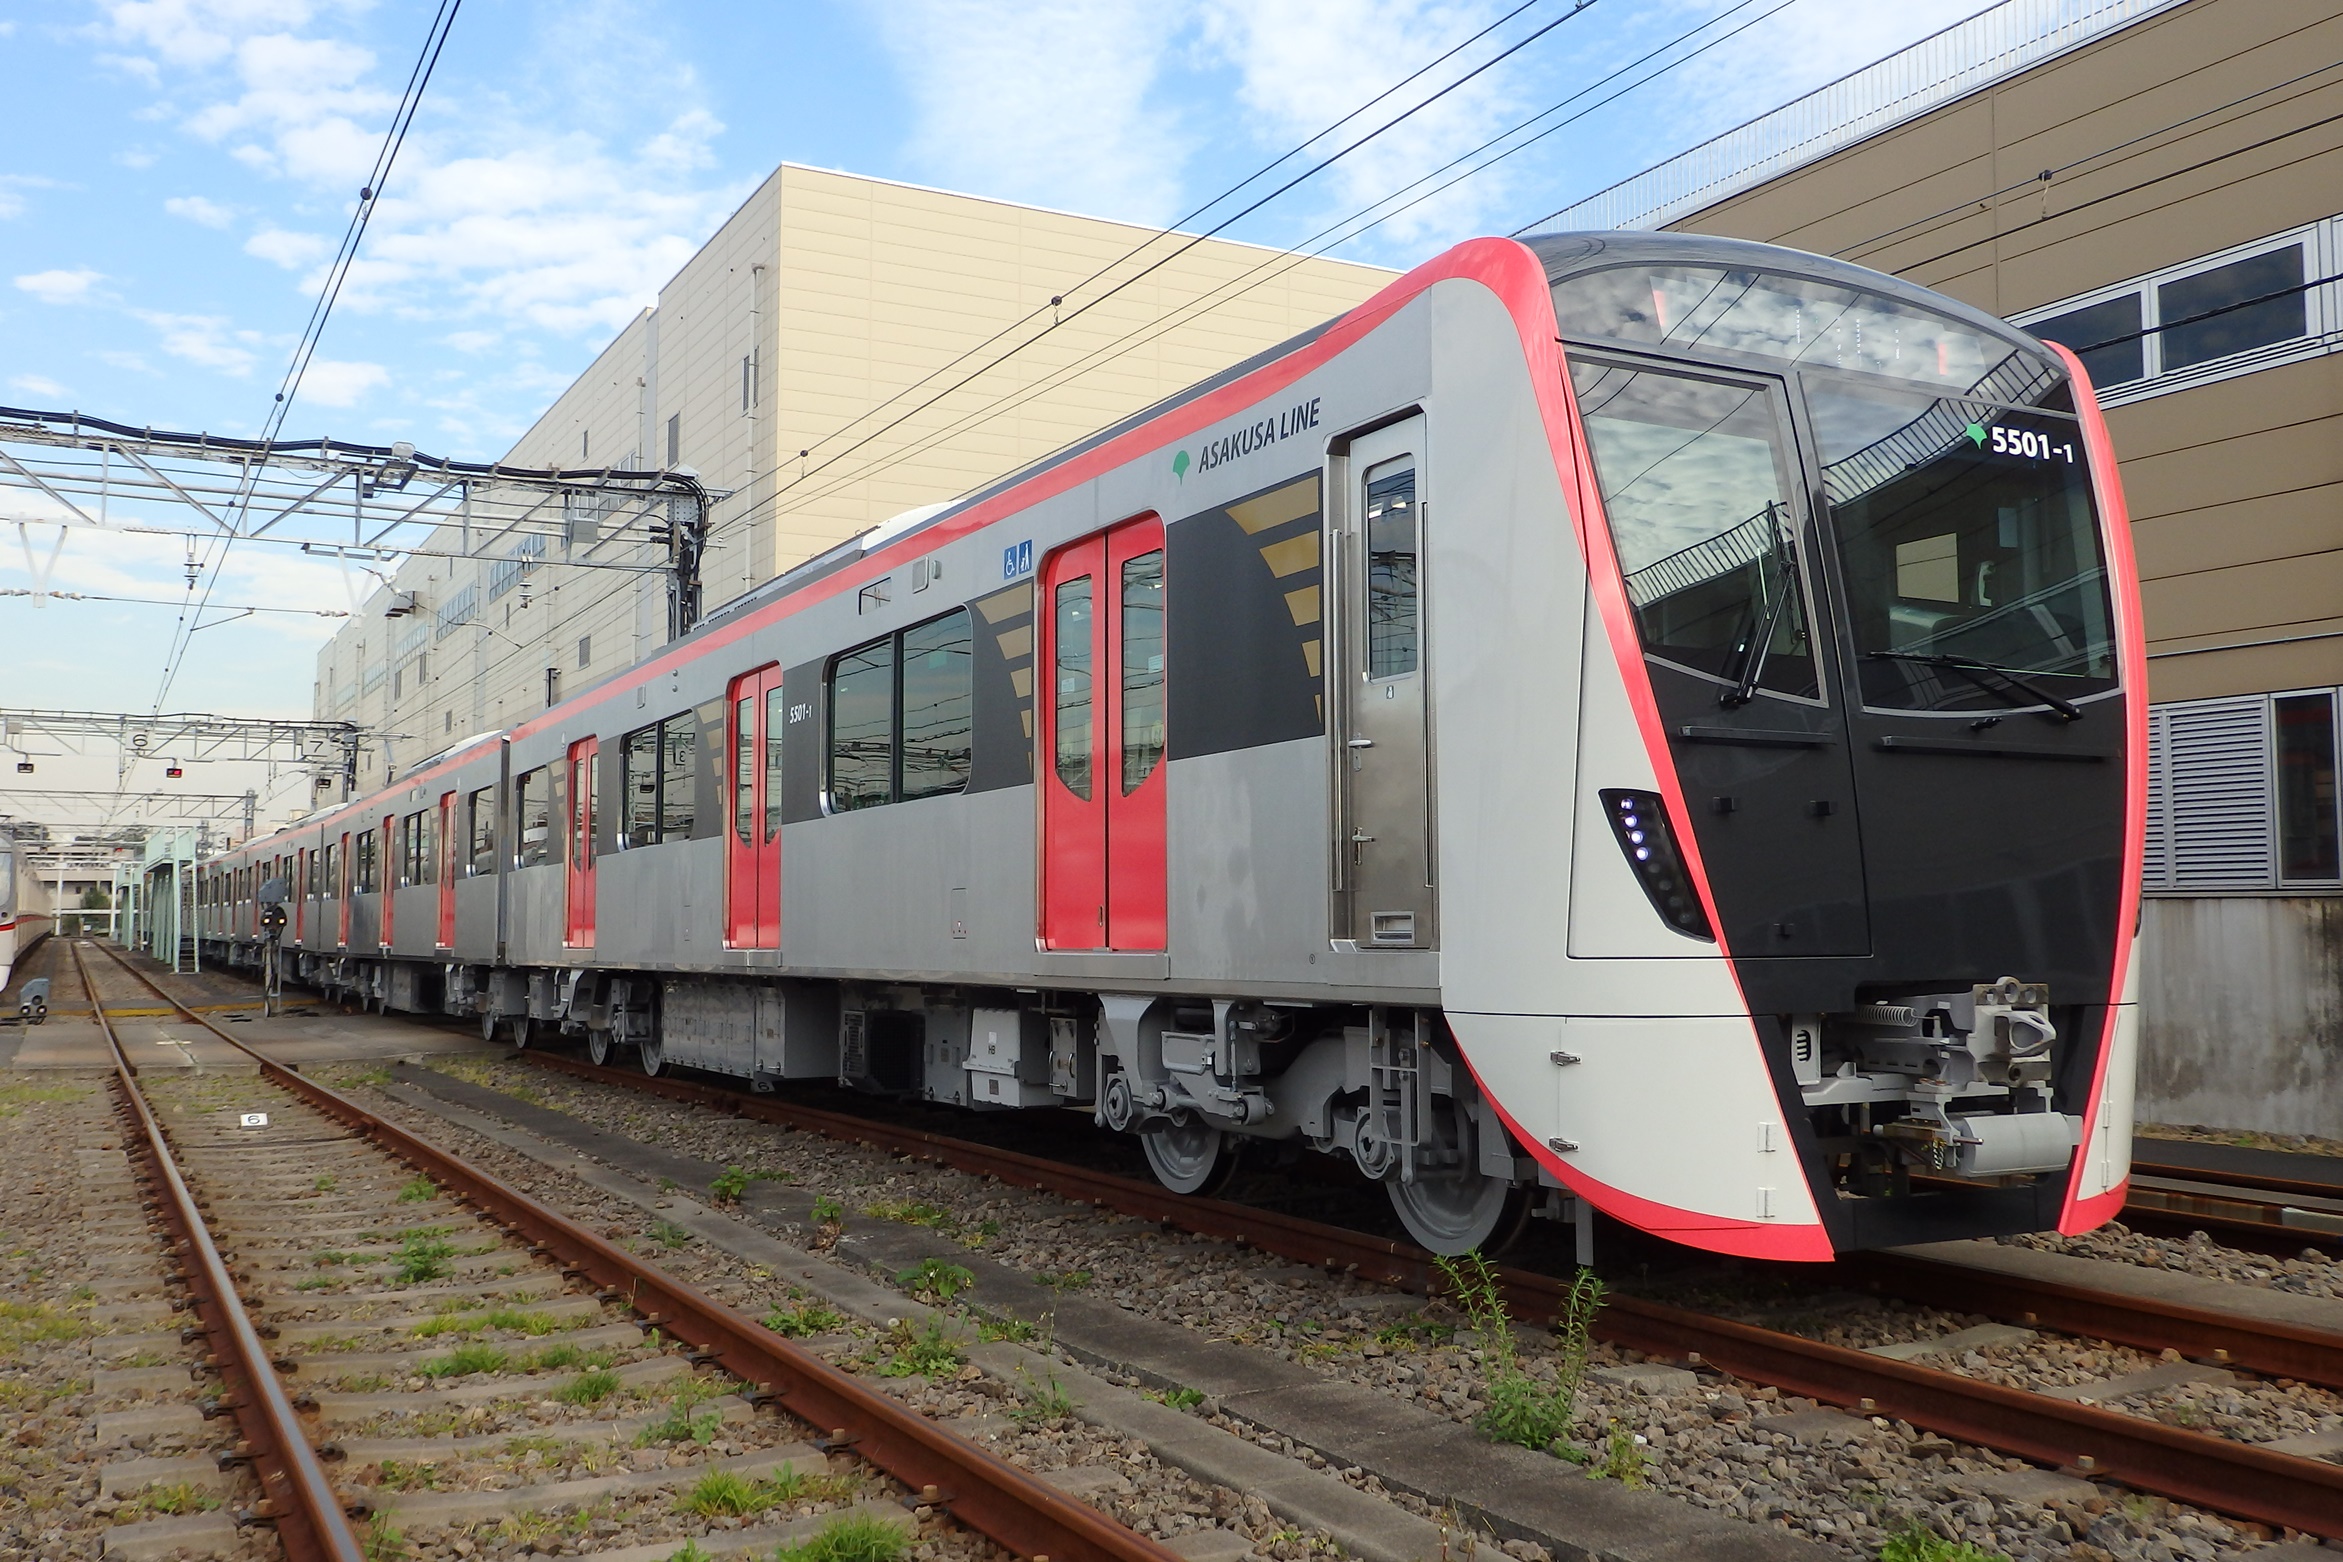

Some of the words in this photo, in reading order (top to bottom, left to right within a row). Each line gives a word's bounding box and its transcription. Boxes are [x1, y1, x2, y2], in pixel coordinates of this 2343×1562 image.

[1199, 417, 1275, 474] ASAKUSA
[1280, 396, 1321, 440] LINE
[1992, 426, 2074, 463] 5501-1
[790, 703, 812, 724] 5501-1
[133, 734, 148, 747] 6
[310, 740, 323, 753] 7
[758, 1081, 770, 1091] 6
[247, 1115, 260, 1125] 6
